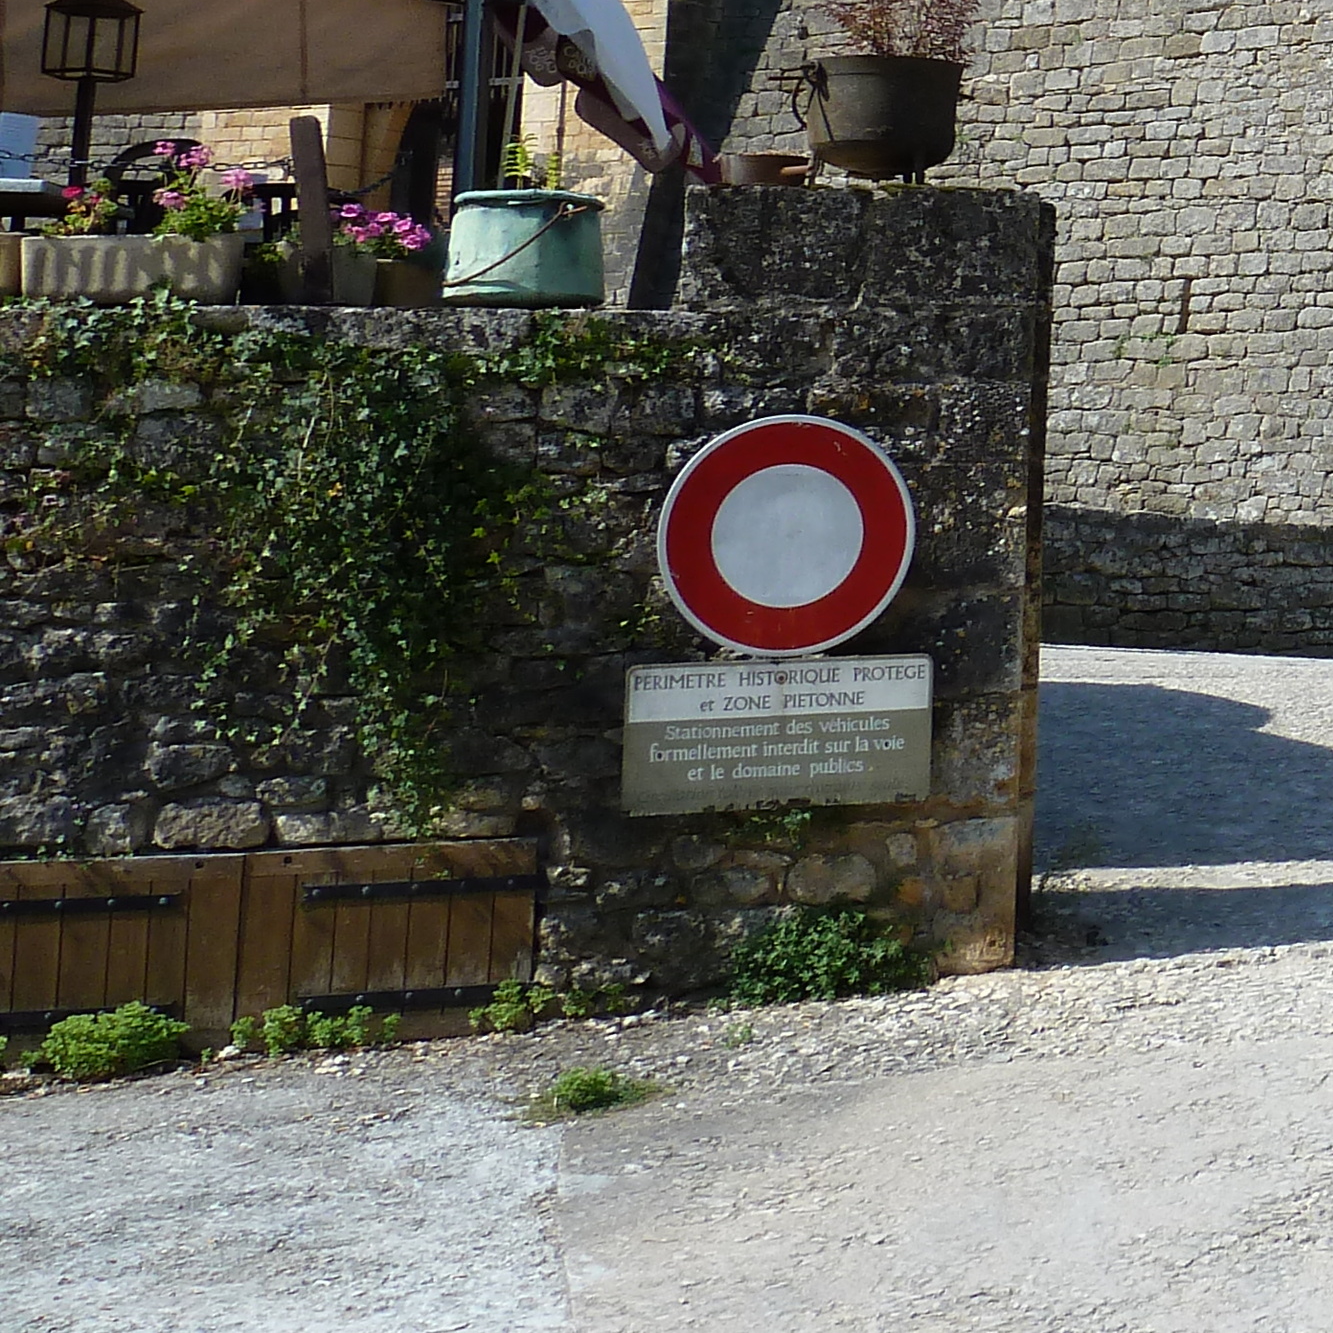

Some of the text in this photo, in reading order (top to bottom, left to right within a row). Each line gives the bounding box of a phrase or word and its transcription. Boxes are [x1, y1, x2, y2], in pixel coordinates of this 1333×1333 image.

[634, 665, 926, 691] PERIMETRE HISTORIQUE PROTEGE
[700, 691, 865, 712] et ZONE PIETONNE
[664, 722, 780, 741] Stationnement
[785, 718, 813, 735] des
[649, 735, 905, 763] formellement interdit sur la voie
[687, 757, 865, 781] et le domaine publics
